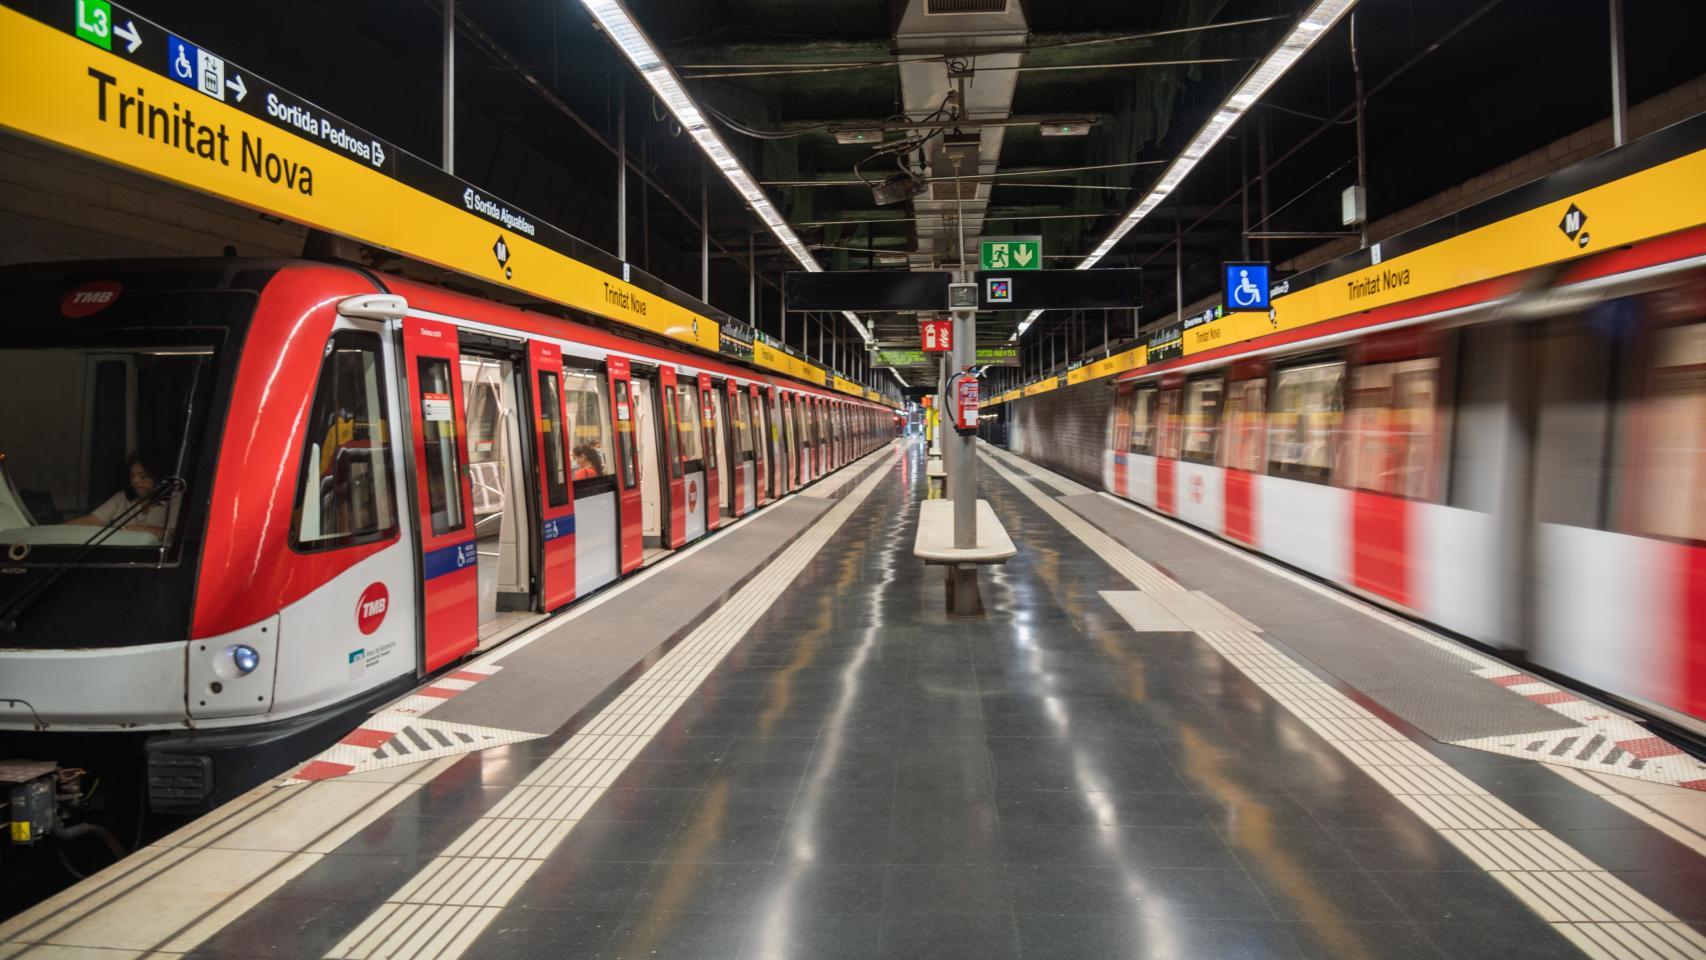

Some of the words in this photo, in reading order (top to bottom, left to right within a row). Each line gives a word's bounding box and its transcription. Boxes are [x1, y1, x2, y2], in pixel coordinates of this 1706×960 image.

[79, 0, 109, 38] L3
[87, 66, 230, 167] Trinitat
[241, 130, 314, 196] Nova
[266, 92, 319, 136] Sortida
[321, 118, 371, 160] Pedrosa
[474, 194, 500, 220] Sortida
[500, 207, 535, 236] Aiguablava
[1566, 211, 1580, 234] M
[496, 242, 507, 262] M
[72, 291, 114, 304] TMB
[603, 281, 630, 311] Trinitat
[630, 291, 647, 317] Nova
[1347, 274, 1380, 301] Trinitat
[1382, 268, 1410, 292] Nova
[362, 597, 387, 619] TMB
